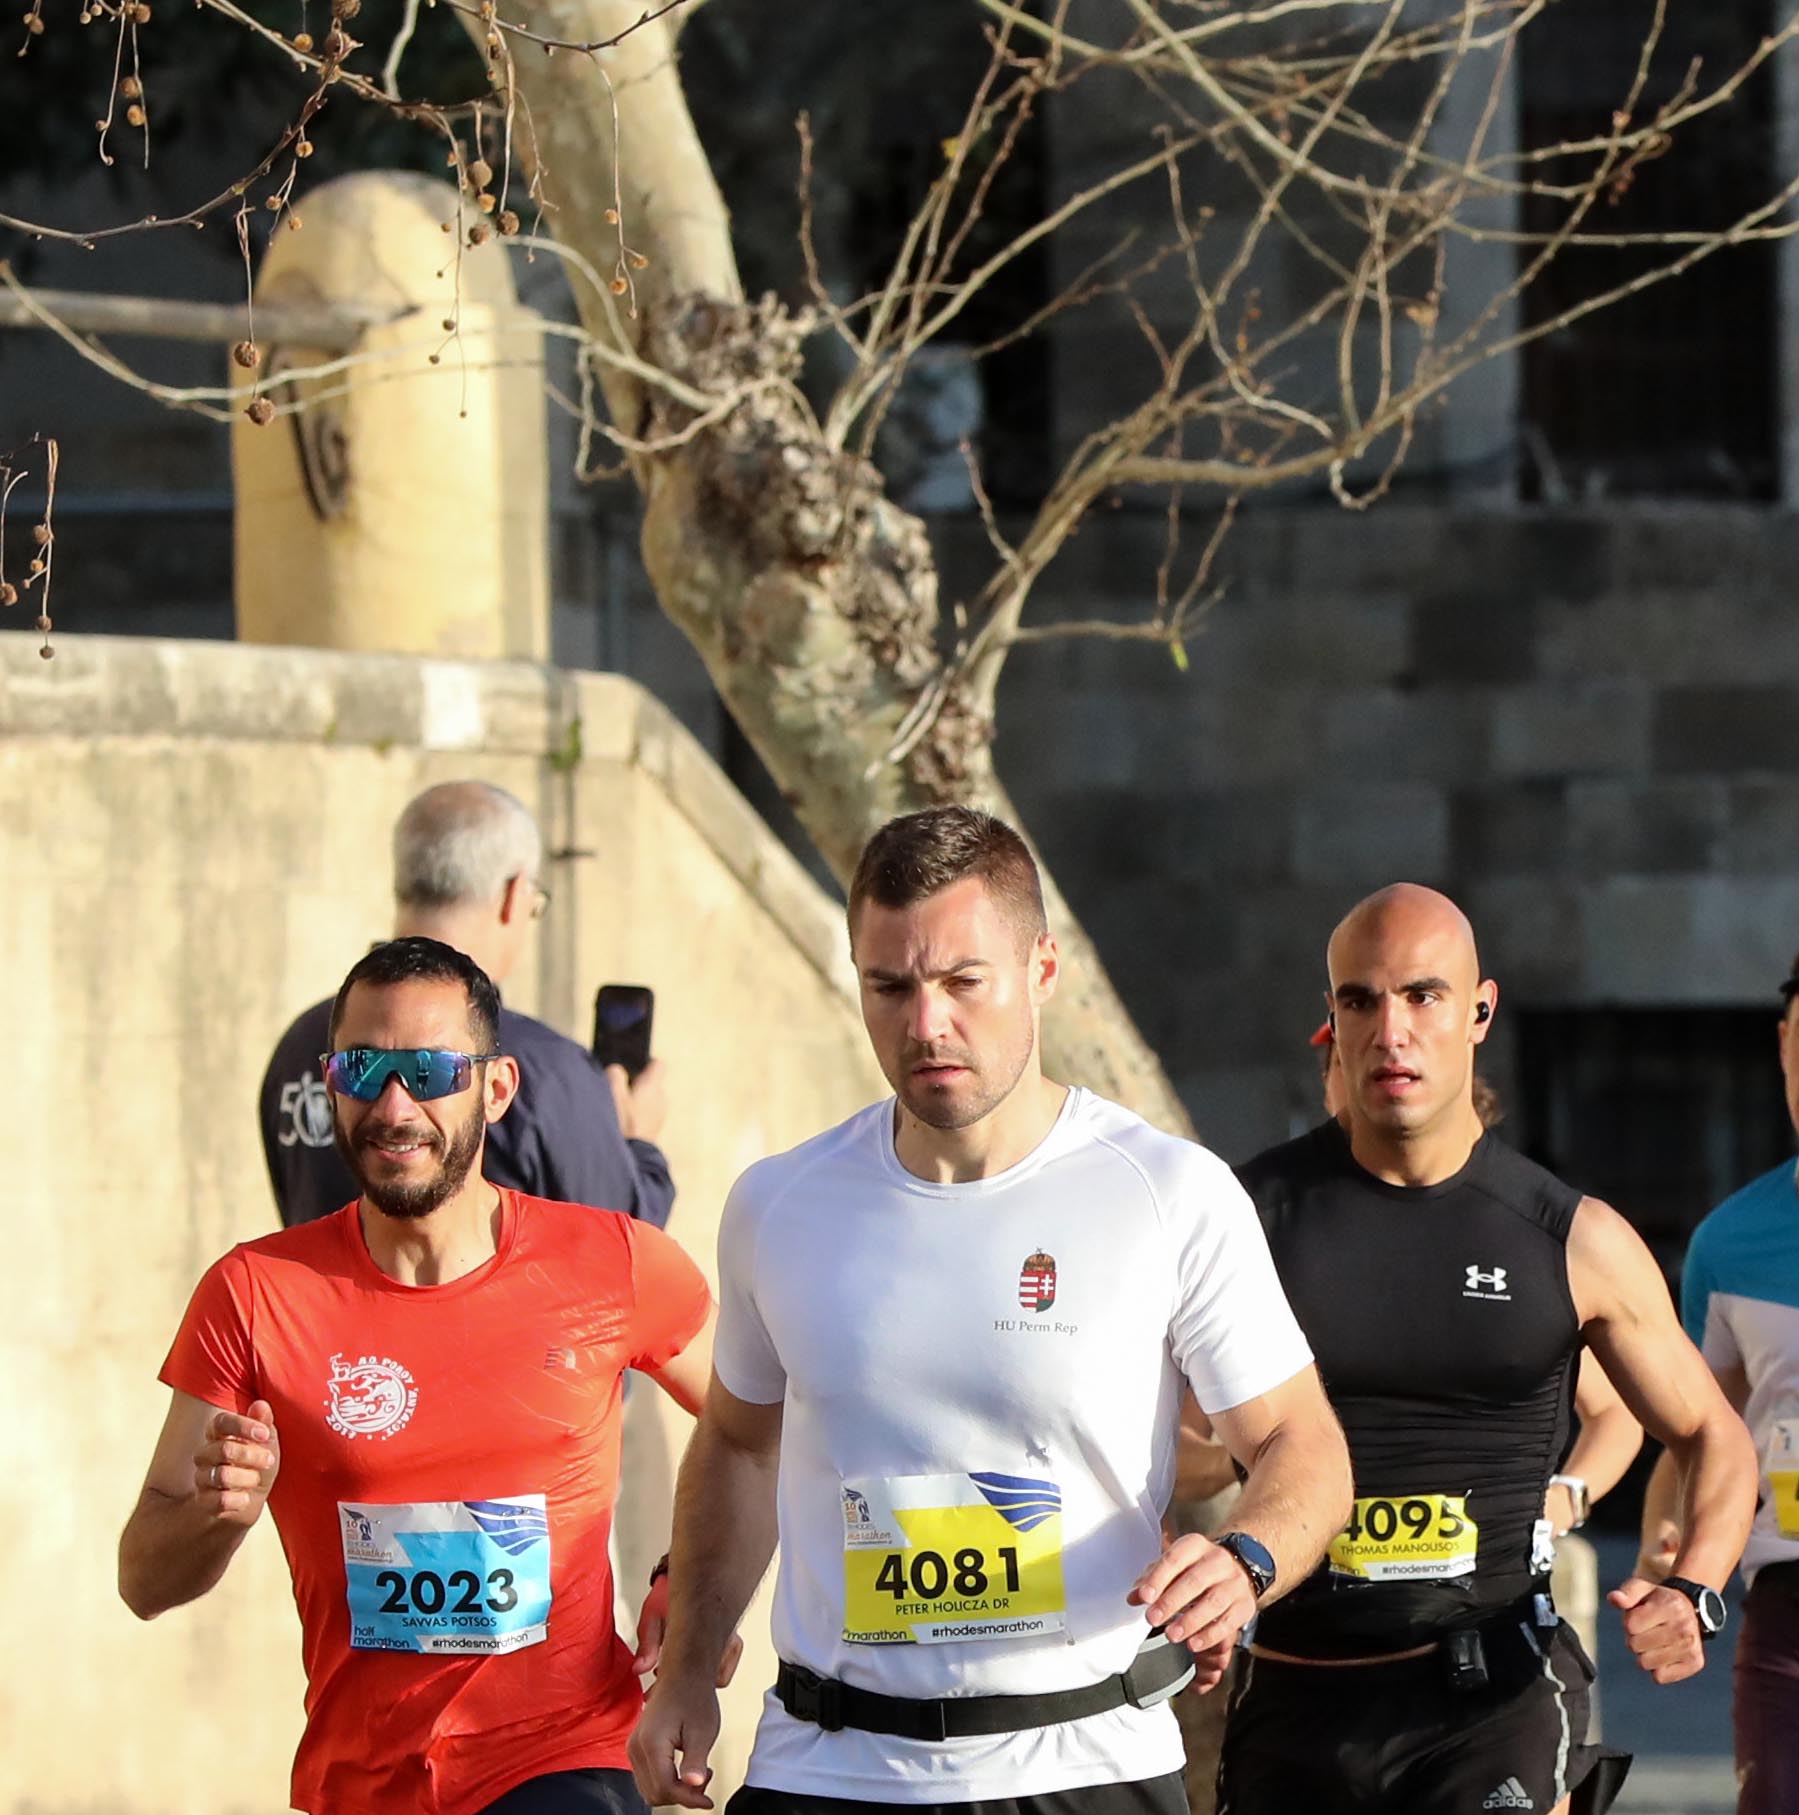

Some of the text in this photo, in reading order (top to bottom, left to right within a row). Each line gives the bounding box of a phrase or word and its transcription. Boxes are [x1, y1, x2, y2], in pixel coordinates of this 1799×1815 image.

[994, 1320, 1079, 1336] HU Perm Rep
[1344, 1500, 1465, 1542] 4095
[1341, 1544, 1389, 1556] THOMAS
[875, 1547, 1020, 1601] 4081
[1382, 1557, 1475, 1575] #rhodesmar
[376, 1568, 519, 1615] 2023
[896, 1597, 1010, 1616] PETER HOLICZA DR
[402, 1616, 497, 1628] SAVVAS POTSOS
[932, 1618, 1044, 1638] #rhodesmarathon
[354, 1626, 375, 1637] half
[847, 1629, 907, 1642] marathon
[354, 1637, 410, 1649] marathon
[432, 1631, 529, 1650] #rhodesmarathon
[1482, 1796, 1534, 1810] adidas
